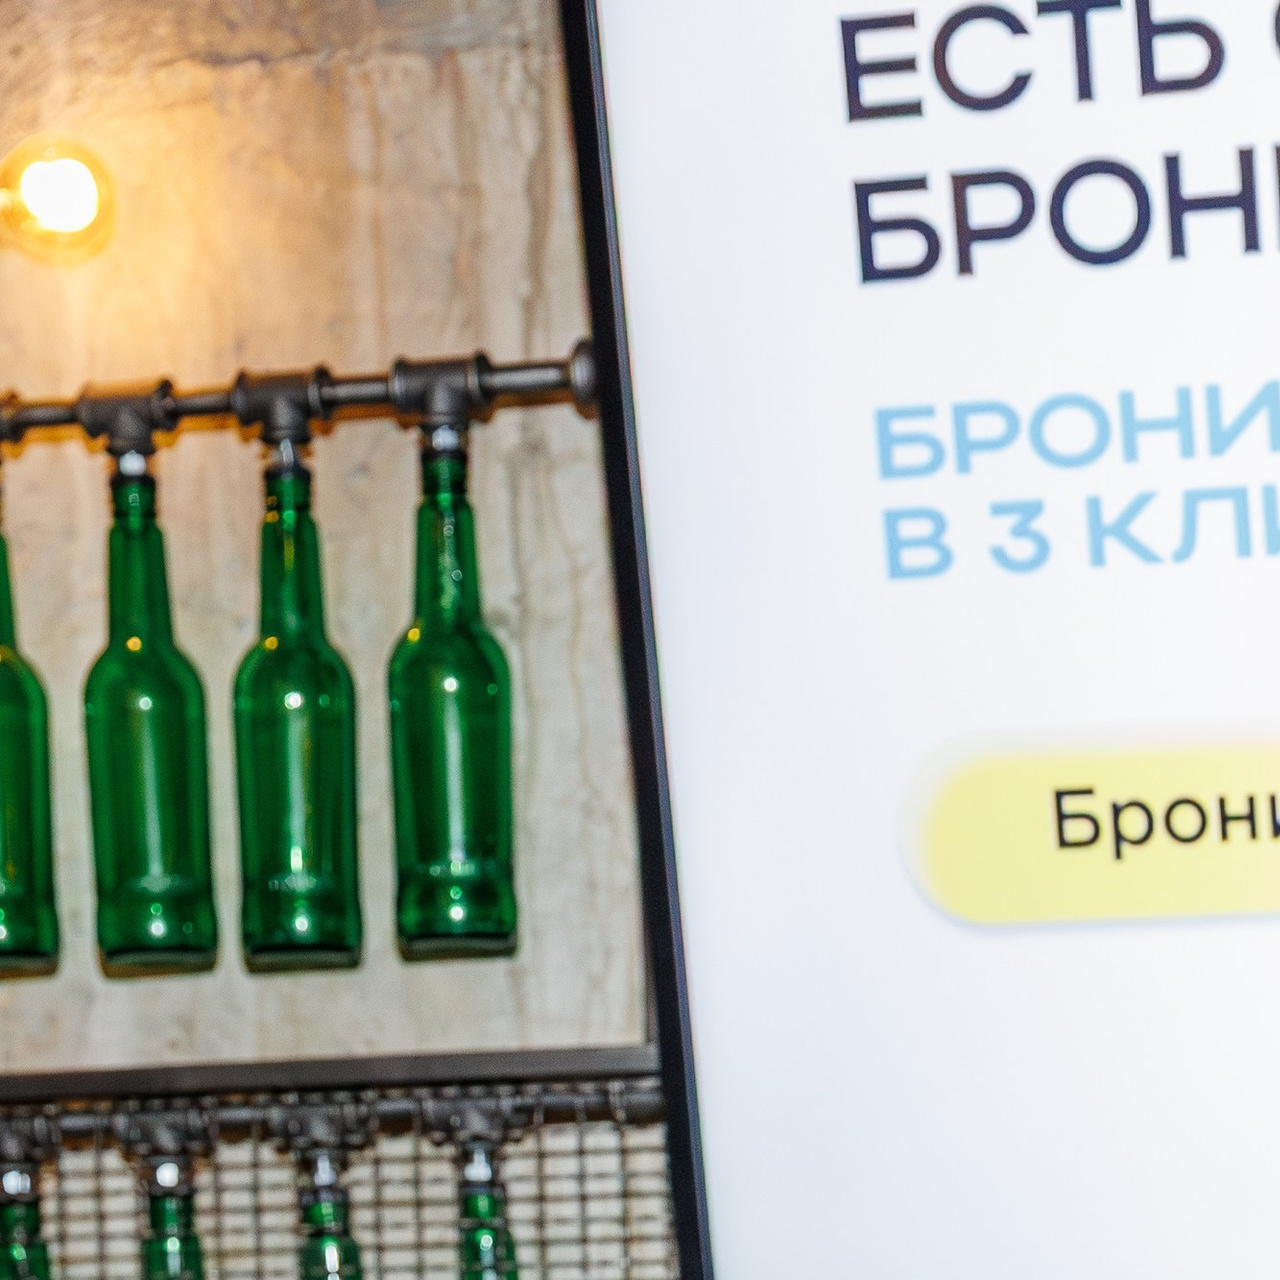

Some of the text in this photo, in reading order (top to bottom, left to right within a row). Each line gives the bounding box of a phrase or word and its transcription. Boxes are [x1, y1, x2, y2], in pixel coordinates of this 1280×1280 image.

[839, 0, 1226, 123] ЕСТЬ
[881, 505, 956, 582] В
[987, 497, 1053, 576] 3
